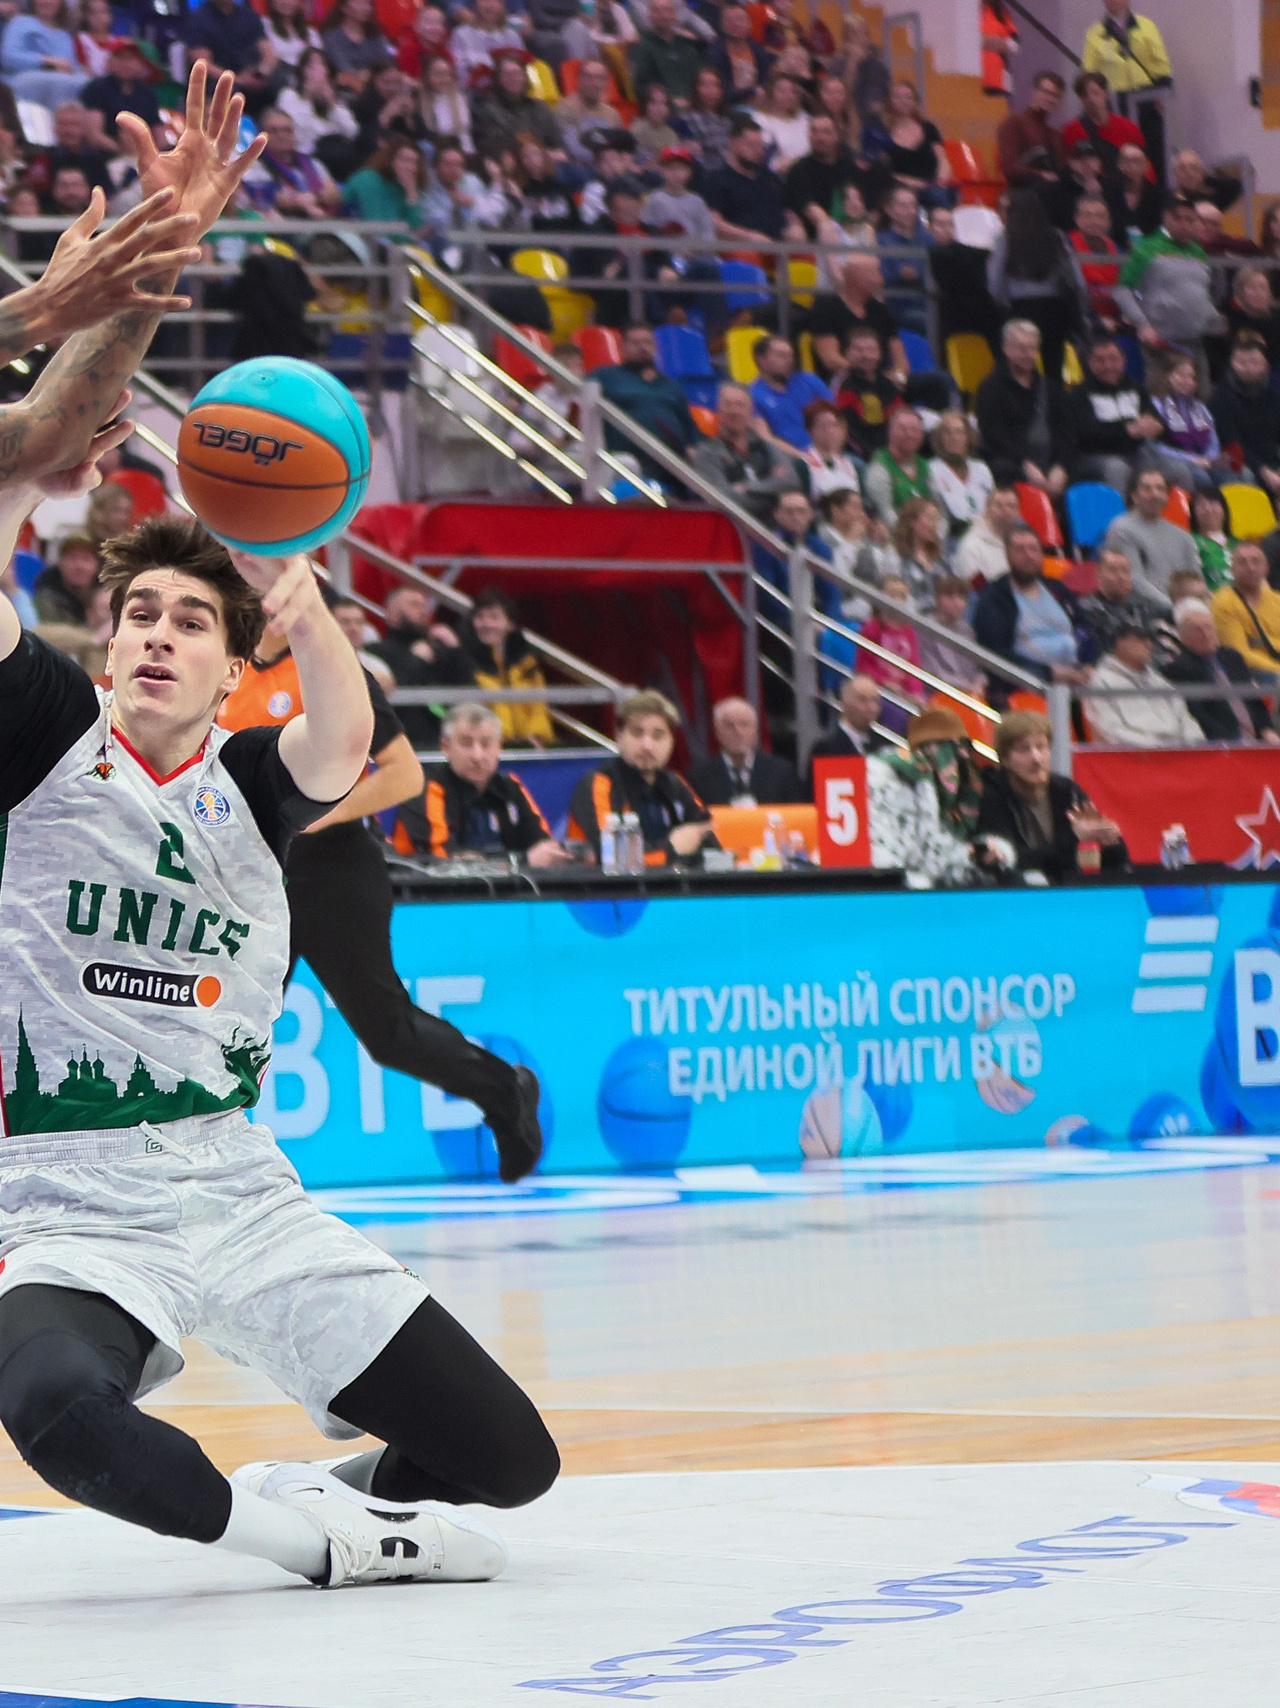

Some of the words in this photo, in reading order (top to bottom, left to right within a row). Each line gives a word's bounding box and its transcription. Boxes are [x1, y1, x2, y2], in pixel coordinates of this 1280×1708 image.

[193, 421, 305, 466] JÖGEL
[824, 778, 860, 846] 5
[155, 821, 197, 885] 2
[65, 879, 250, 961] UNICS
[94, 966, 191, 1003] Winline
[623, 970, 880, 1036] ТИТУЛЬНЫЙ
[889, 972, 1076, 1025] СПОНСОР
[668, 1032, 844, 1103] ЕДИНОЙ
[855, 1034, 962, 1087] ЛИГИ
[971, 1033, 1043, 1079] ВТБ
[513, 1516, 1240, 1700] АЭРОФЛОТ
